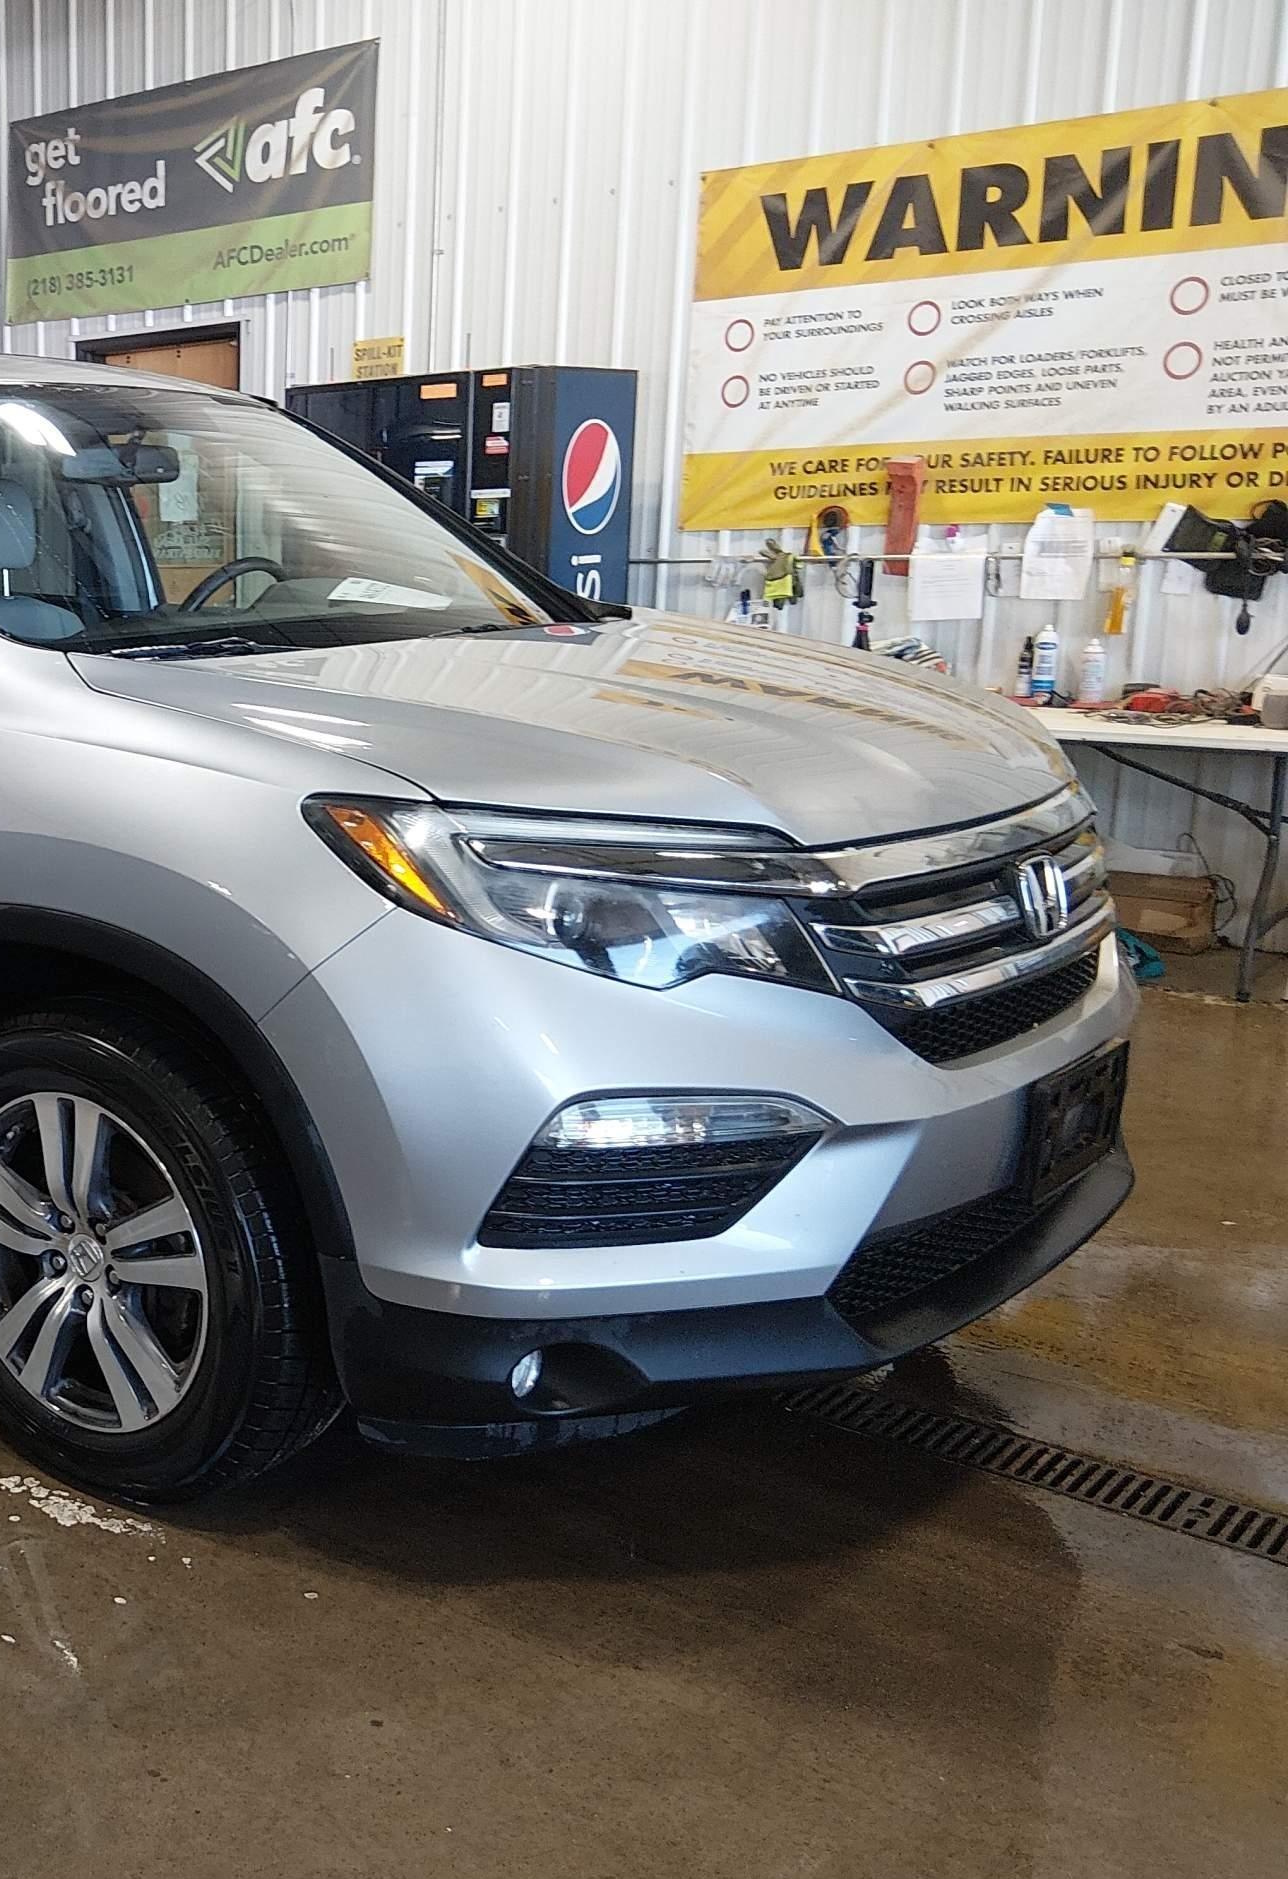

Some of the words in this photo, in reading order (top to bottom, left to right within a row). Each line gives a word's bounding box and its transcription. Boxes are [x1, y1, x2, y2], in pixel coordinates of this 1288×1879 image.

[24, 127, 81, 186] get
[41, 159, 166, 226] floored
[761, 125, 1288, 271] WARNIN
[213, 237, 350, 271] AFCDealer.com
[27, 275, 62, 299] (218)
[65, 265, 134, 291] 385-3131
[1220, 273, 1272, 286] CLOSED
[951, 299, 985, 310] LOOK
[989, 295, 1021, 306] BOTH
[1023, 290, 1059, 302] WAYS
[1062, 287, 1104, 299] WHEN
[1219, 290, 1256, 303] MUST
[1260, 288, 1276, 300] BE
[763, 317, 782, 327] PAY
[784, 311, 844, 324] ATTENTION
[847, 309, 862, 319] TO
[950, 310, 1011, 325] CROSSING
[1013, 307, 1054, 319] AISLES
[763, 330, 791, 341] YOUR
[795, 322, 884, 338] SURROUNDINGS
[354, 344, 403, 362] SPILL-KIT
[1214, 337, 1264, 351] HEALTH
[946, 357, 988, 369] WATCH
[991, 355, 1017, 366] FOR
[1212, 355, 1241, 366] NOT
[356, 362, 399, 379] STATION
[759, 373, 777, 383] NO
[780, 369, 827, 381] VEHICLES
[829, 365, 874, 377] SHOULD
[944, 371, 993, 383] JAGGED
[1041, 365, 1080, 377] LOOSE
[1210, 370, 1272, 382] AUCTION
[759, 387, 771, 397] BE
[774, 384, 813, 395] DRIVEN
[815, 382, 831, 393] OR
[834, 379, 880, 391] STARTED
[944, 386, 984, 398] SHARP
[987, 384, 1032, 395] POINTS
[1035, 381, 1062, 392] AND
[1065, 379, 1118, 391] UNEVEN
[758, 401, 771, 410] AT
[773, 397, 819, 409] ANYTIME
[944, 401, 1000, 412] WALKING
[1003, 397, 1062, 409] SURFACES
[1206, 403, 1225, 414] BY
[1228, 402, 1250, 413] AN
[769, 461, 798, 476] WE
[802, 457, 849, 475] CARE
[959, 449, 1035, 469] SAFETY.
[1043, 447, 1124, 465] FAILURE
[1133, 446, 1160, 462] TO
[1168, 443, 1264, 461] FOLLOW
[1272, 442, 1288, 459] P
[774, 481, 879, 500] GUIDELINES
[935, 478, 1003, 495] RESULT
[1009, 476, 1032, 492] IN
[1039, 474, 1128, 492] SERIOUS
[1135, 472, 1217, 490] INJURY
[1225, 471, 1260, 488] OR
